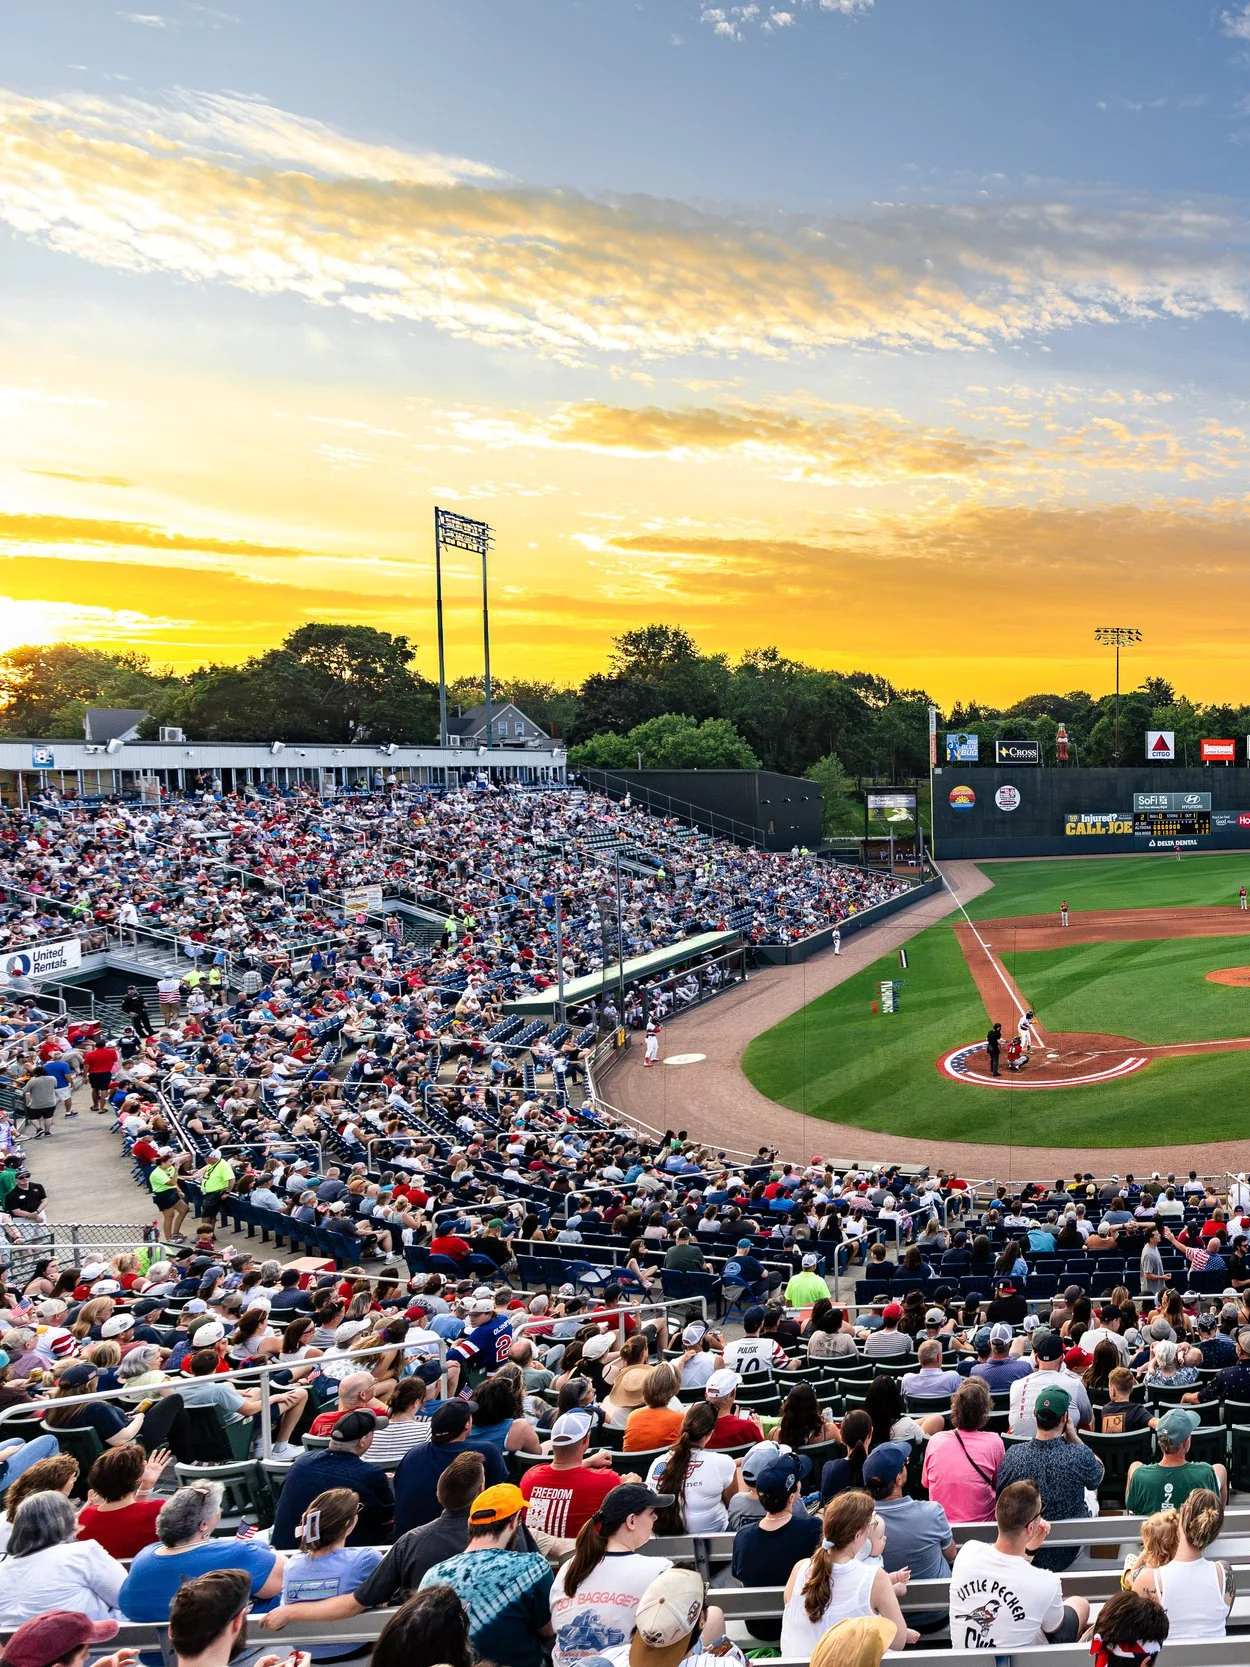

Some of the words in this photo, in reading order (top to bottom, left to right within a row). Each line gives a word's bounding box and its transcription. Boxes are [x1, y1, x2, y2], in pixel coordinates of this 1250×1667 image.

[1138, 796, 1157, 805] SoFi
[1081, 814, 1117, 823] Injured?
[1066, 822, 1106, 835] CALL
[1108, 821, 1133, 834] JOE
[33, 946, 64, 962] United
[33, 958, 67, 974] Rentals
[495, 1334, 512, 1362] 2
[735, 1358, 760, 1373] 10
[531, 1486, 573, 1499] FREEDOM
[556, 1597, 575, 1611] GOT
[578, 1592, 640, 1609] BAGGAGE?
[957, 1579, 988, 1602] LITTLE
[991, 1581, 1026, 1622] PECHER
